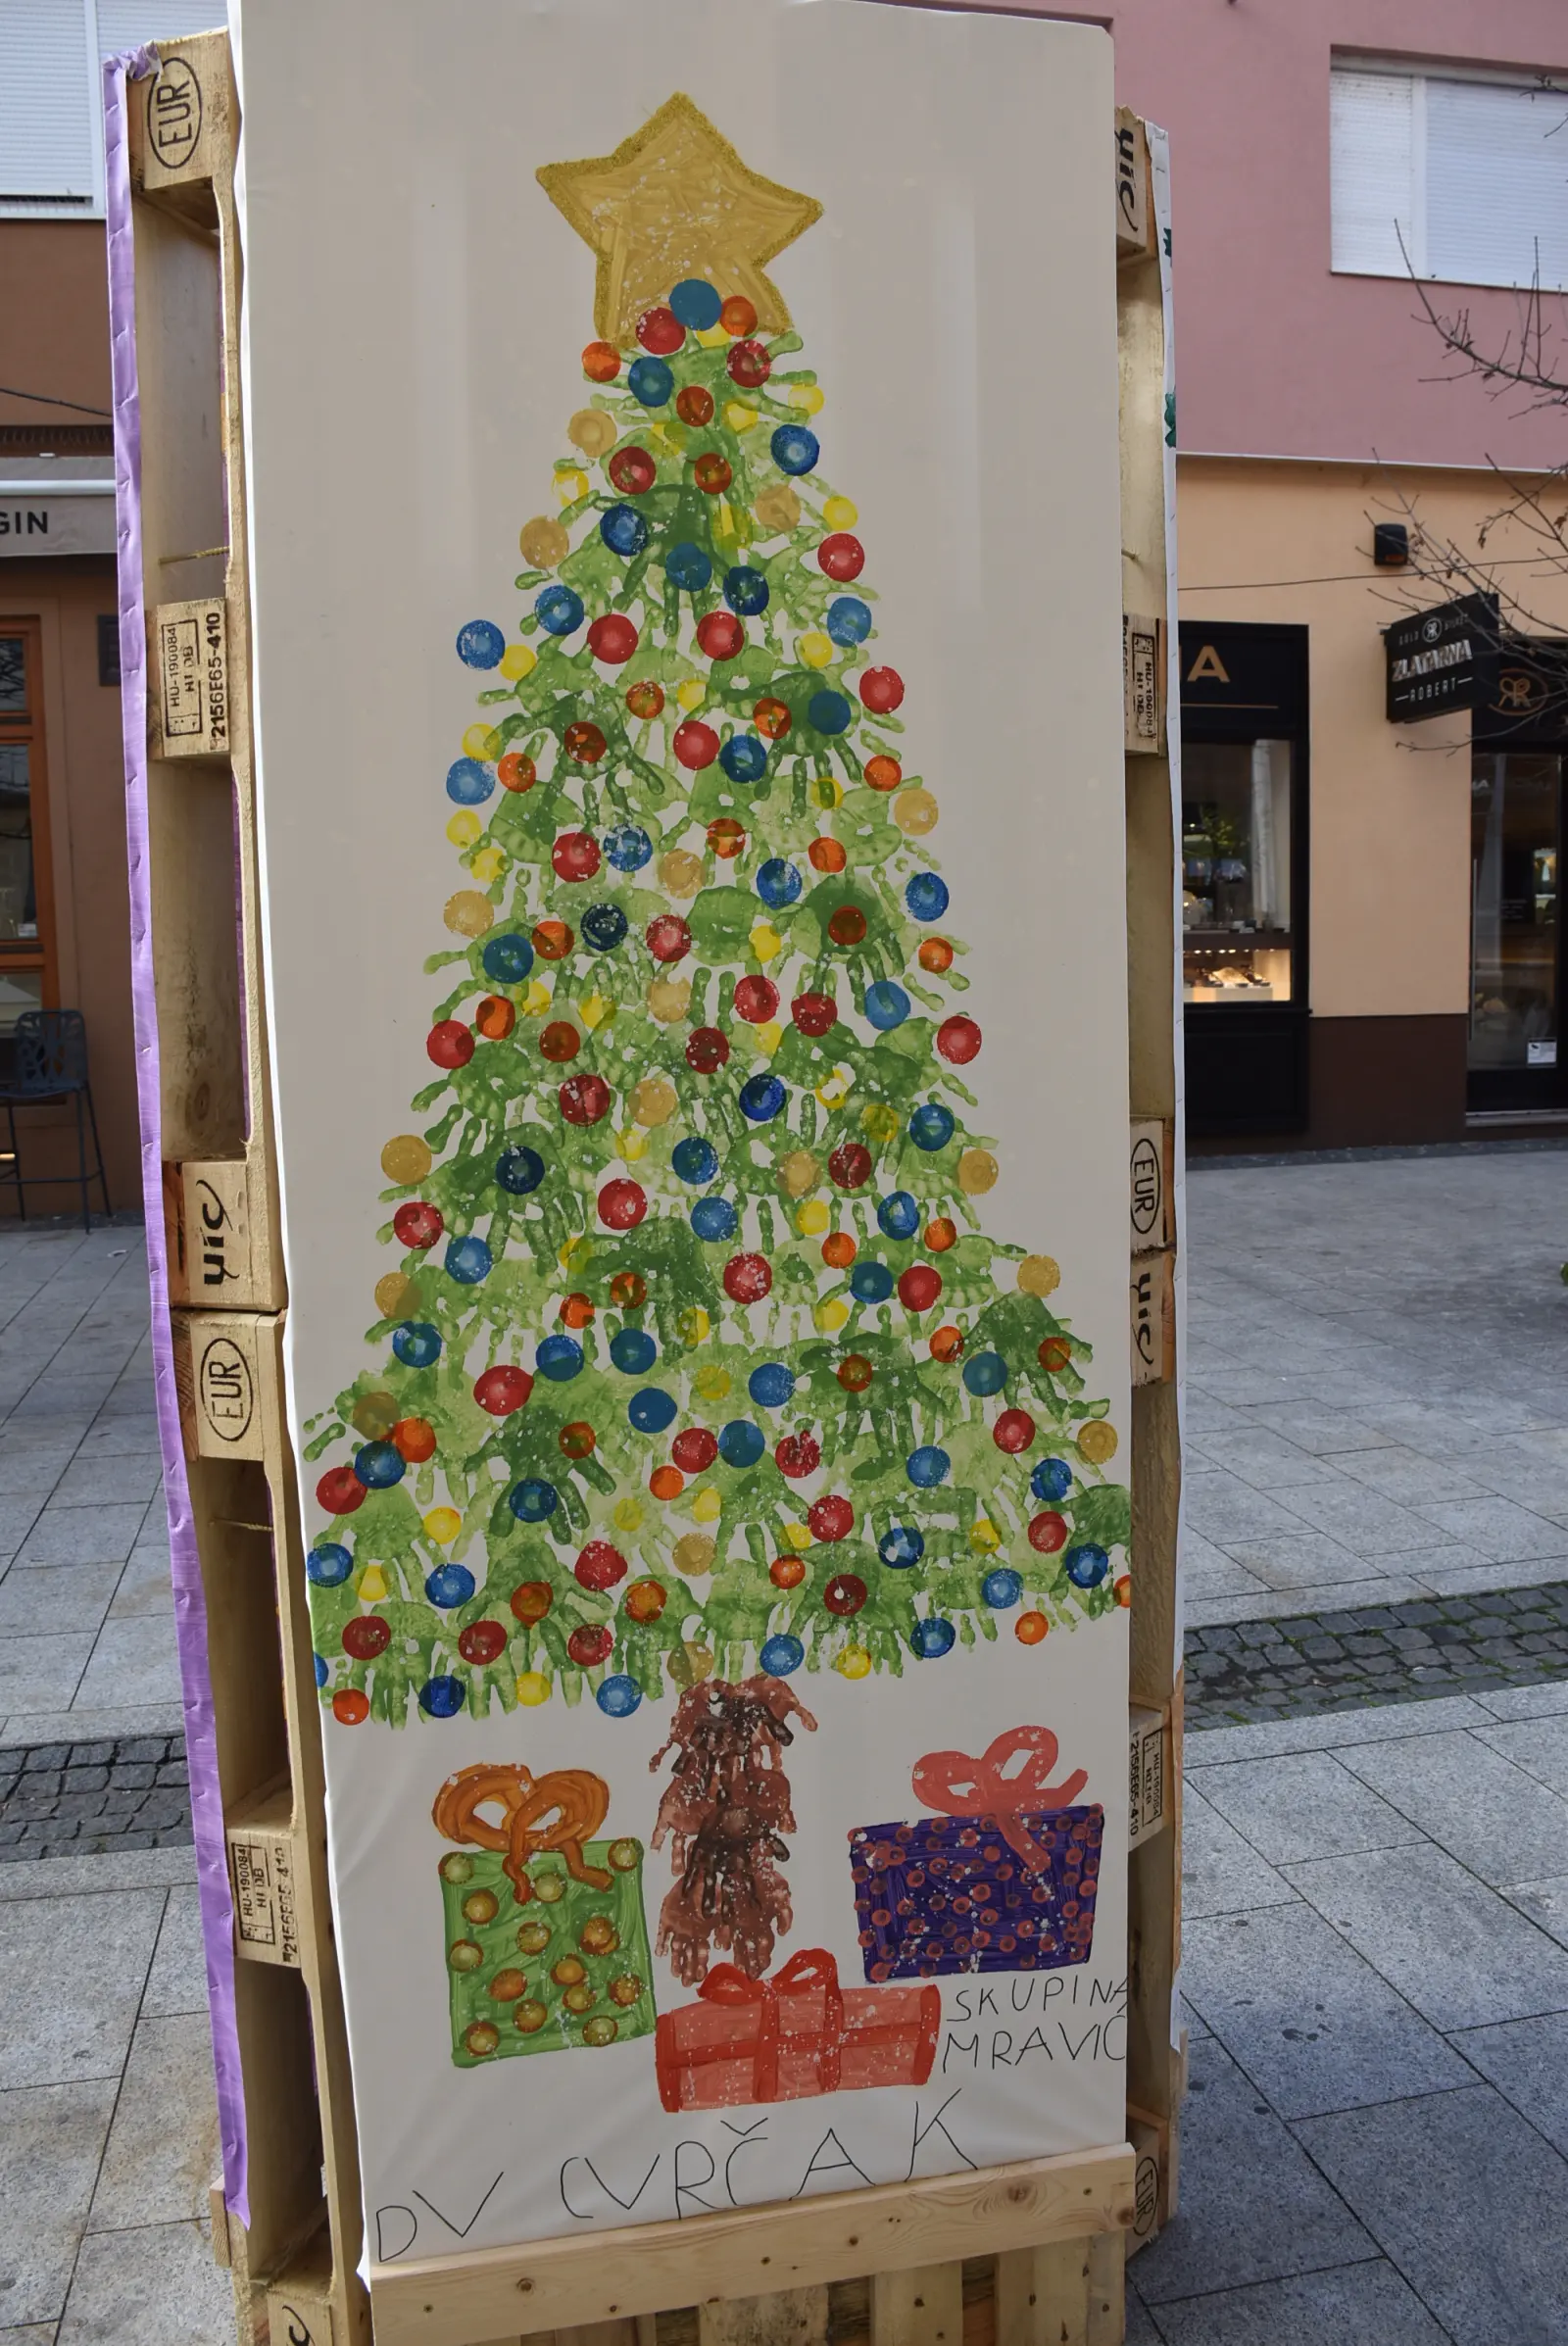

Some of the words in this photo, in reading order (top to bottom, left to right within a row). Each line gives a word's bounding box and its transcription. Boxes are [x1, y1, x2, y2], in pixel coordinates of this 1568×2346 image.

[157, 80, 192, 148] EUR
[168, 627, 180, 708] HU-190084
[1179, 645, 1230, 683] A
[1409, 677, 1457, 702] ROBERT
[1134, 1158, 1154, 1213] EUR
[209, 1361, 244, 1420] EUR
[376, 2172, 504, 2263] DV
